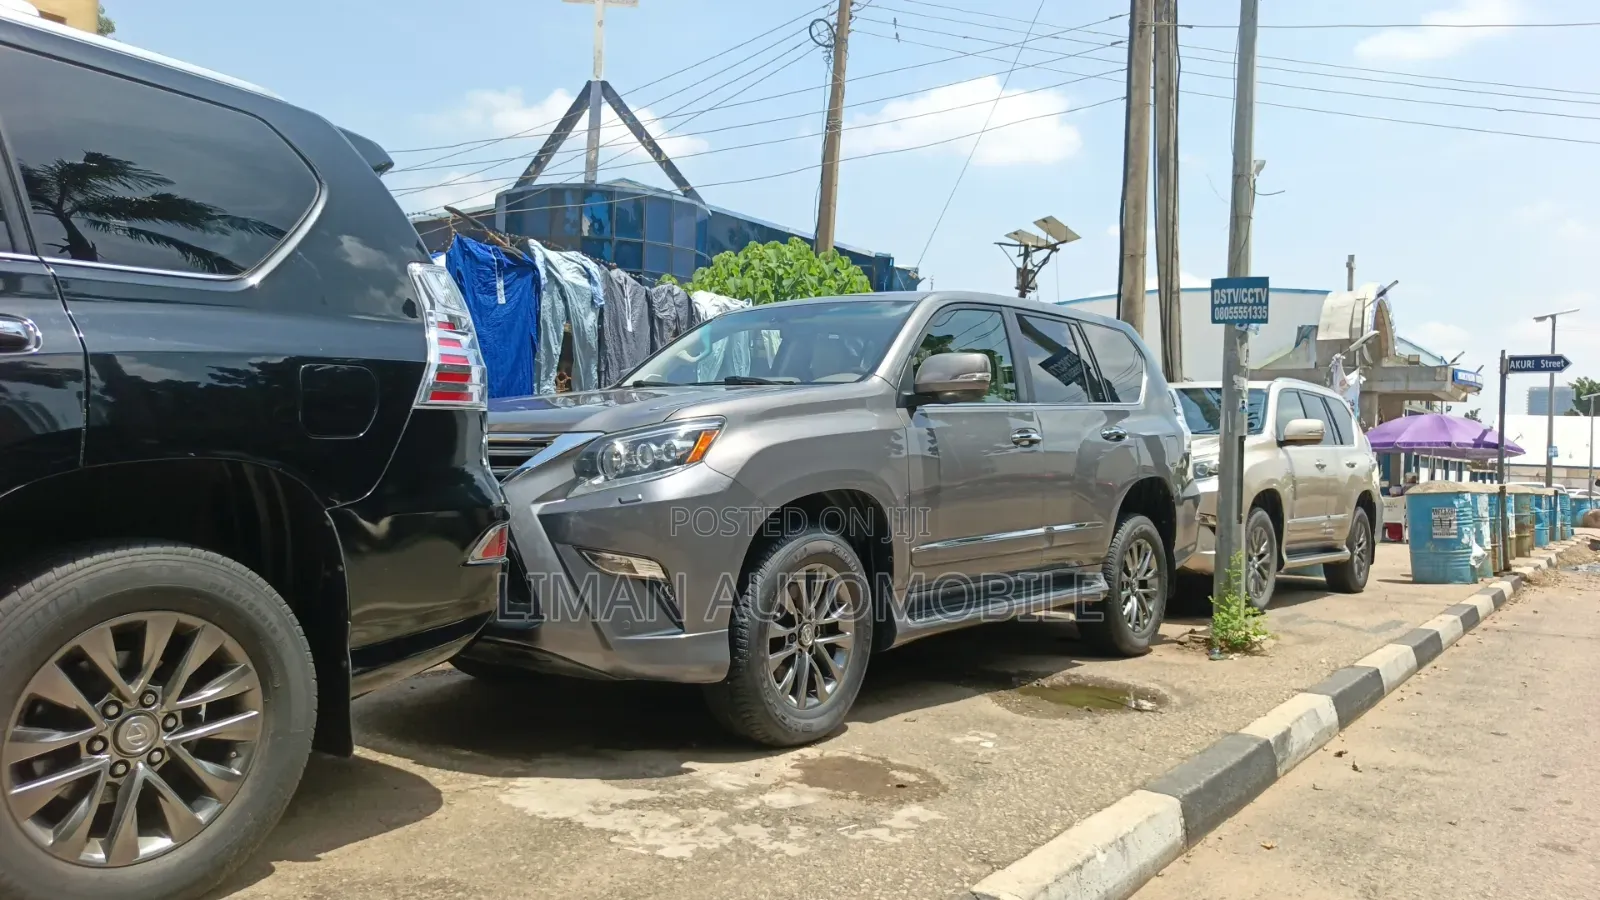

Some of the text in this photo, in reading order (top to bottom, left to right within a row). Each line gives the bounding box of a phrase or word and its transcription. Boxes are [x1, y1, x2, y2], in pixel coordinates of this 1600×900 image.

[1213, 288, 1267, 304] DSTV/CCTV
[1214, 306, 1268, 320] 08055551335
[1540, 359, 1565, 368] Street
